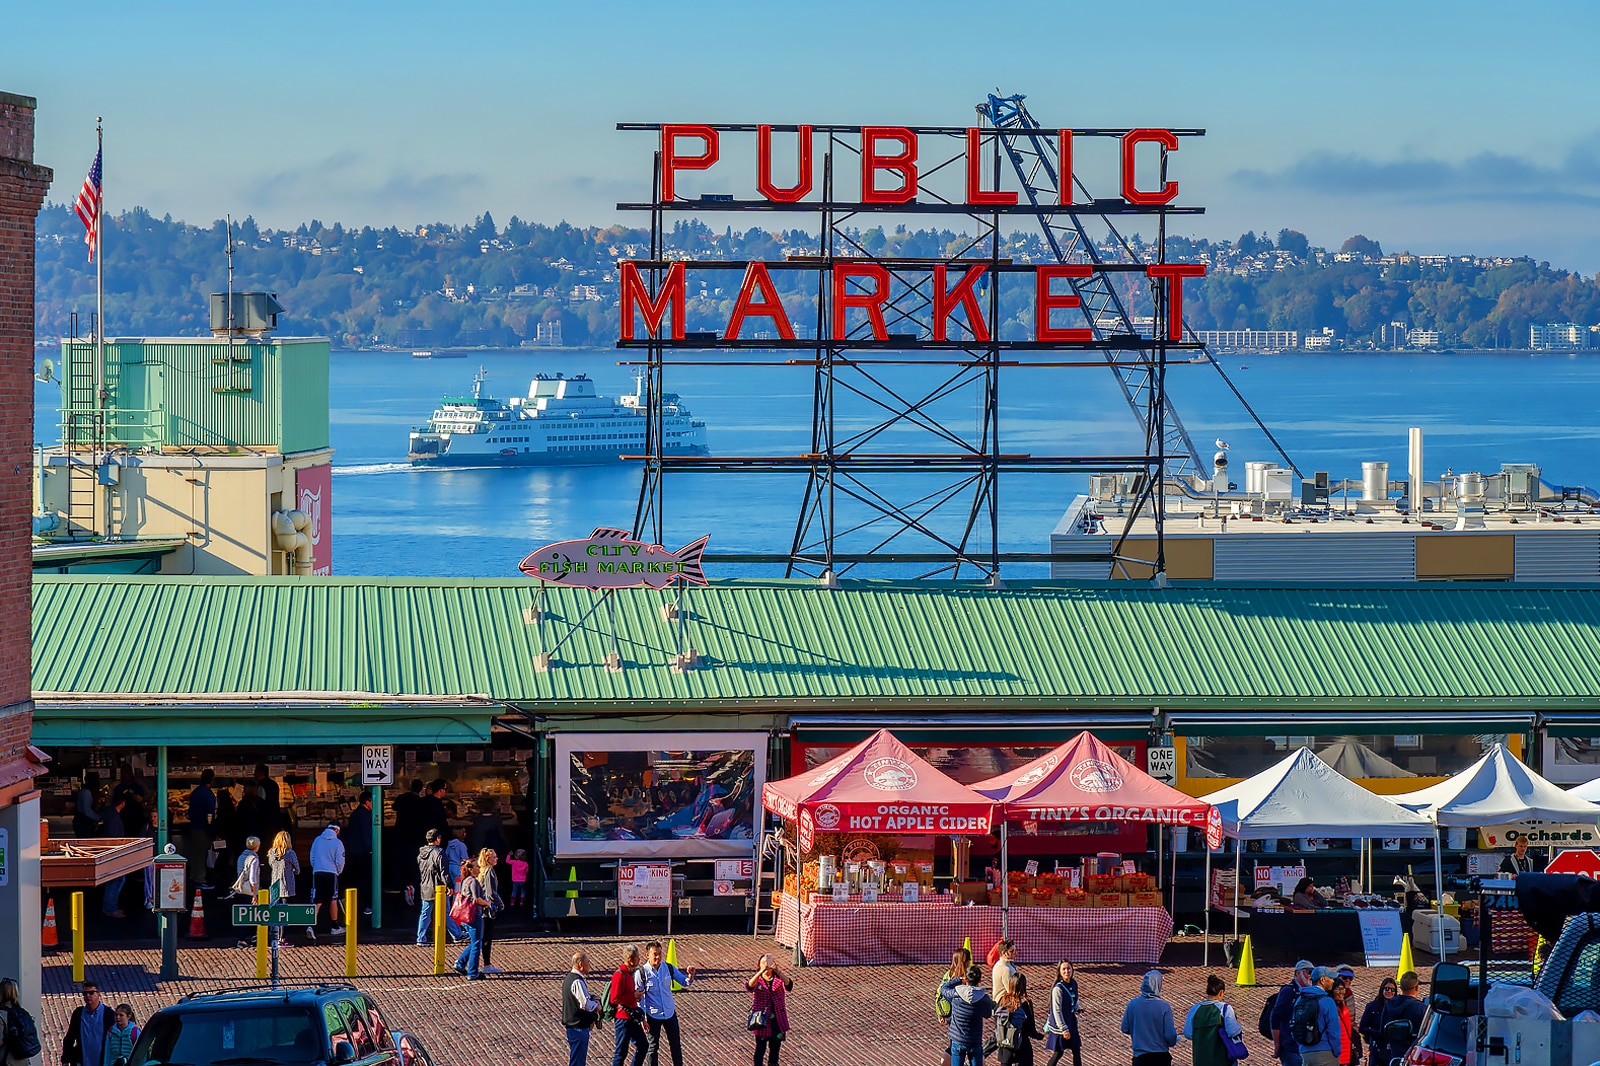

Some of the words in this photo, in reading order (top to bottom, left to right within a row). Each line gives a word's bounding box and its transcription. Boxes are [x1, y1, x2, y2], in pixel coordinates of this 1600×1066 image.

[661, 124, 1179, 205] PUBLIC
[619, 261, 1206, 342] MARKET
[586, 545, 642, 557] CITY
[540, 562, 588, 573] FISH
[598, 562, 687, 573] MARKET
[366, 748, 389, 758] ONE
[1151, 750, 1173, 760] ONE
[366, 759, 389, 769] WAY
[1150, 761, 1173, 771] WAY
[877, 805, 949, 815] ORGANIC
[1028, 807, 1090, 821] TINY'S
[1094, 807, 1191, 824] ORGANIC
[850, 816, 881, 829] HOT
[886, 817, 934, 830] APPLE
[939, 817, 988, 830] CIDER
[742, 861, 752, 874] NO
[621, 868, 634, 879] NO
[1257, 869, 1269, 879] NO
[239, 907, 270, 922] Pike
[305, 907, 315, 915] 60
